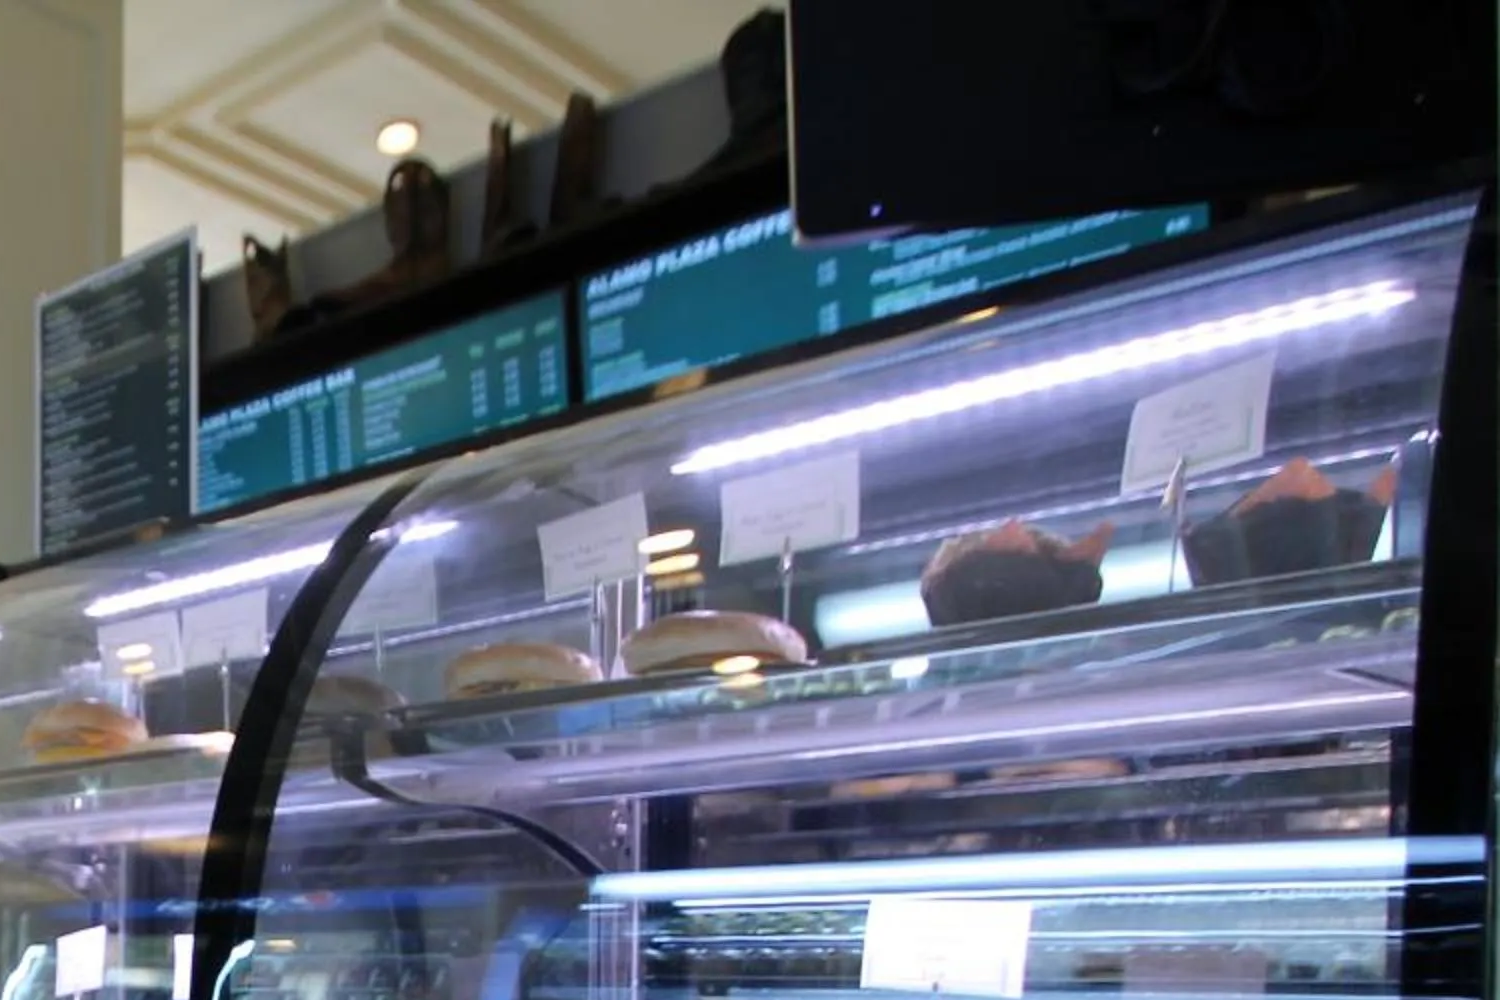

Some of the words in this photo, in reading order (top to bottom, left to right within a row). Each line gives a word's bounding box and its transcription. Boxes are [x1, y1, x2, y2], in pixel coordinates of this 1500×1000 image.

[586, 257, 651, 301] ALAMO
[655, 235, 720, 277] PLAZA
[722, 207, 793, 254] COFFE
[229, 396, 271, 422] PLAZA
[272, 377, 323, 412] COFFEE
[325, 366, 356, 393] BAR
